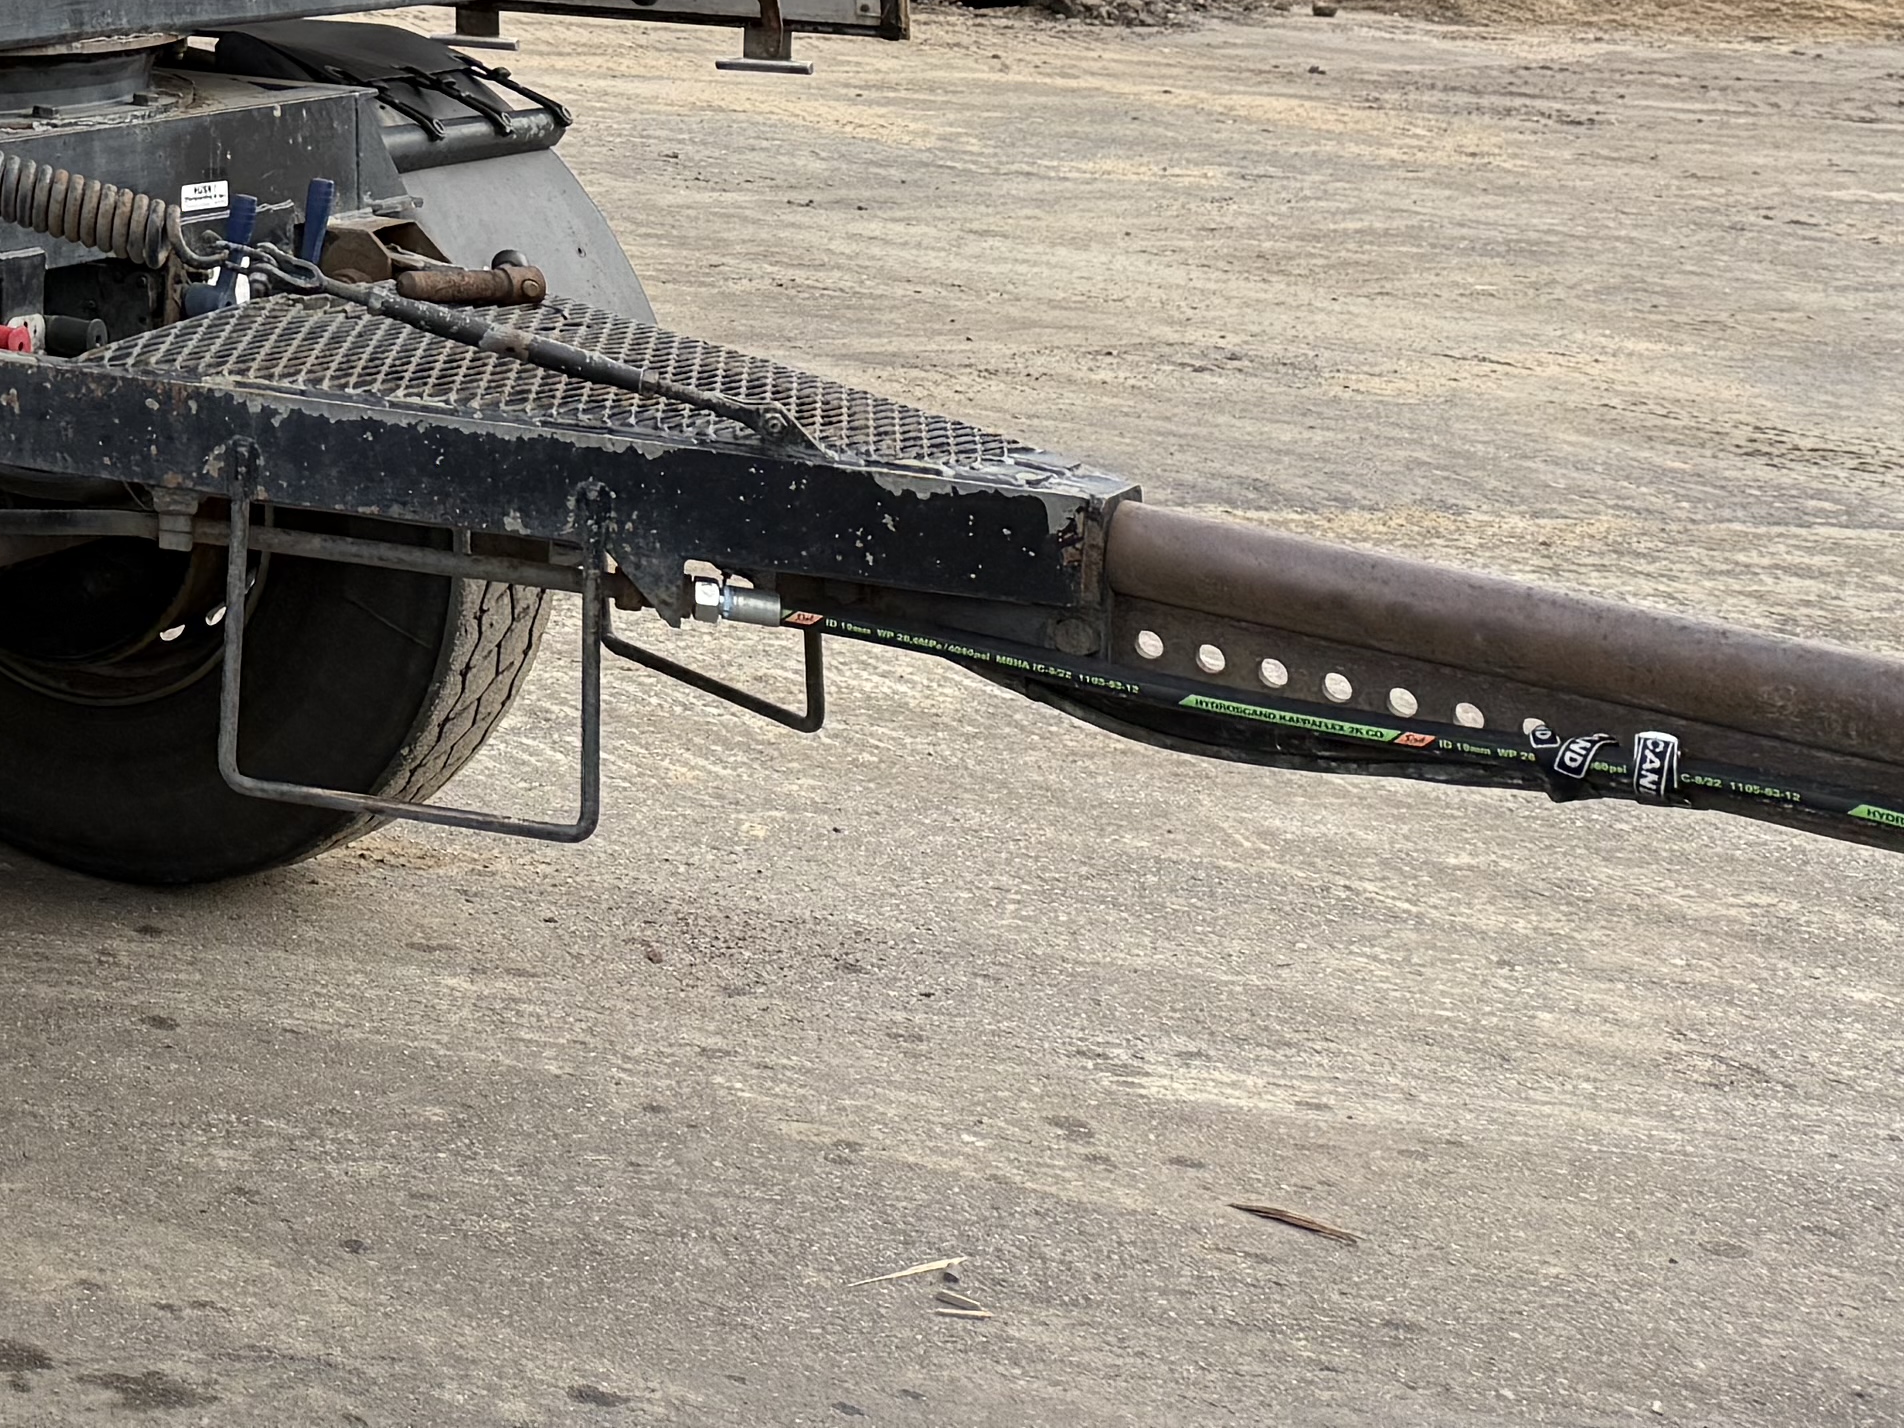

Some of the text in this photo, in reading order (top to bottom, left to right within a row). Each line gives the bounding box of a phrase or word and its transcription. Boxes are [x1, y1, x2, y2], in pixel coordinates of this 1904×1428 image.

[1497, 748, 1517, 758] WP
[1591, 761, 1627, 774] 60psi
[1639, 739, 1665, 795] CAN
